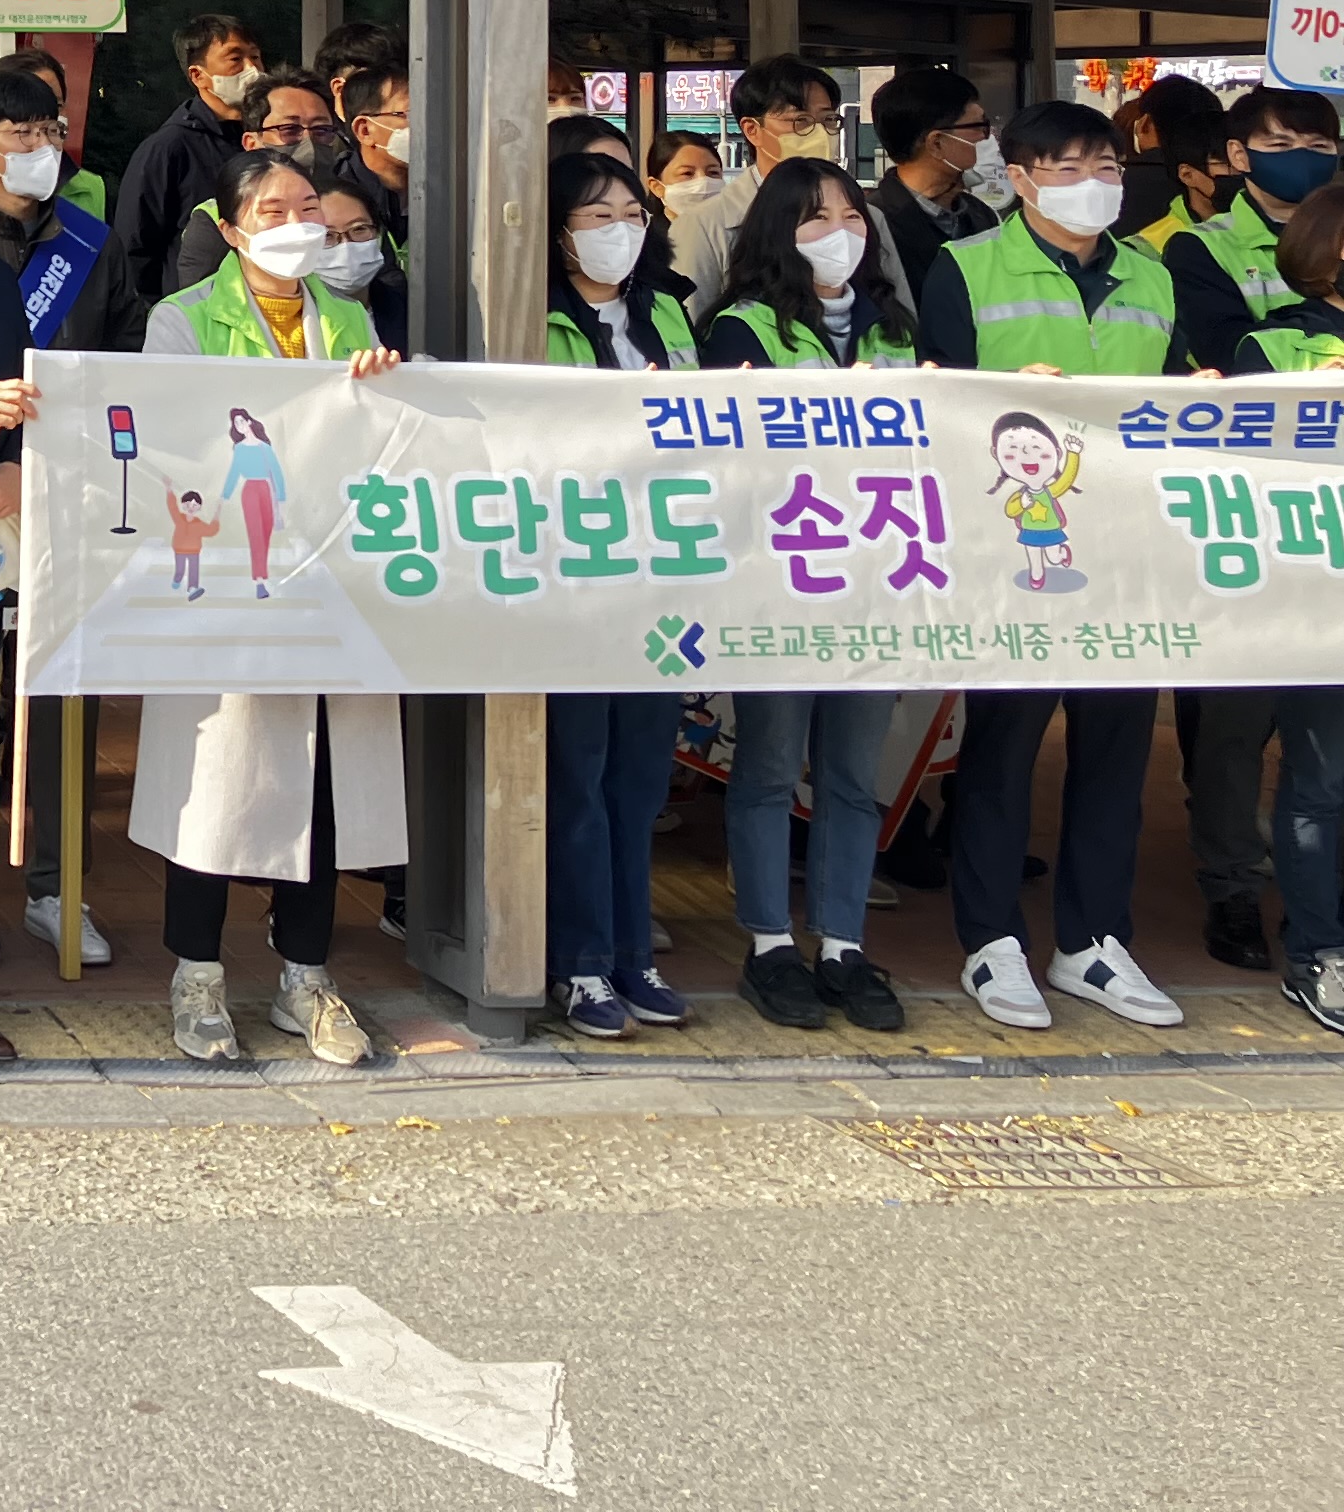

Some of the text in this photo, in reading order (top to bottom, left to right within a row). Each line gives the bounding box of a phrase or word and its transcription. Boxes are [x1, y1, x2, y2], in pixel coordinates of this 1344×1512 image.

[645, 395, 931, 451] 건너 갈래요!
[1118, 398, 1277, 450] 손으로
[347, 472, 728, 597] 횡단보도
[769, 471, 950, 594] 손짓
[717, 623, 903, 662] 도로교통공단
